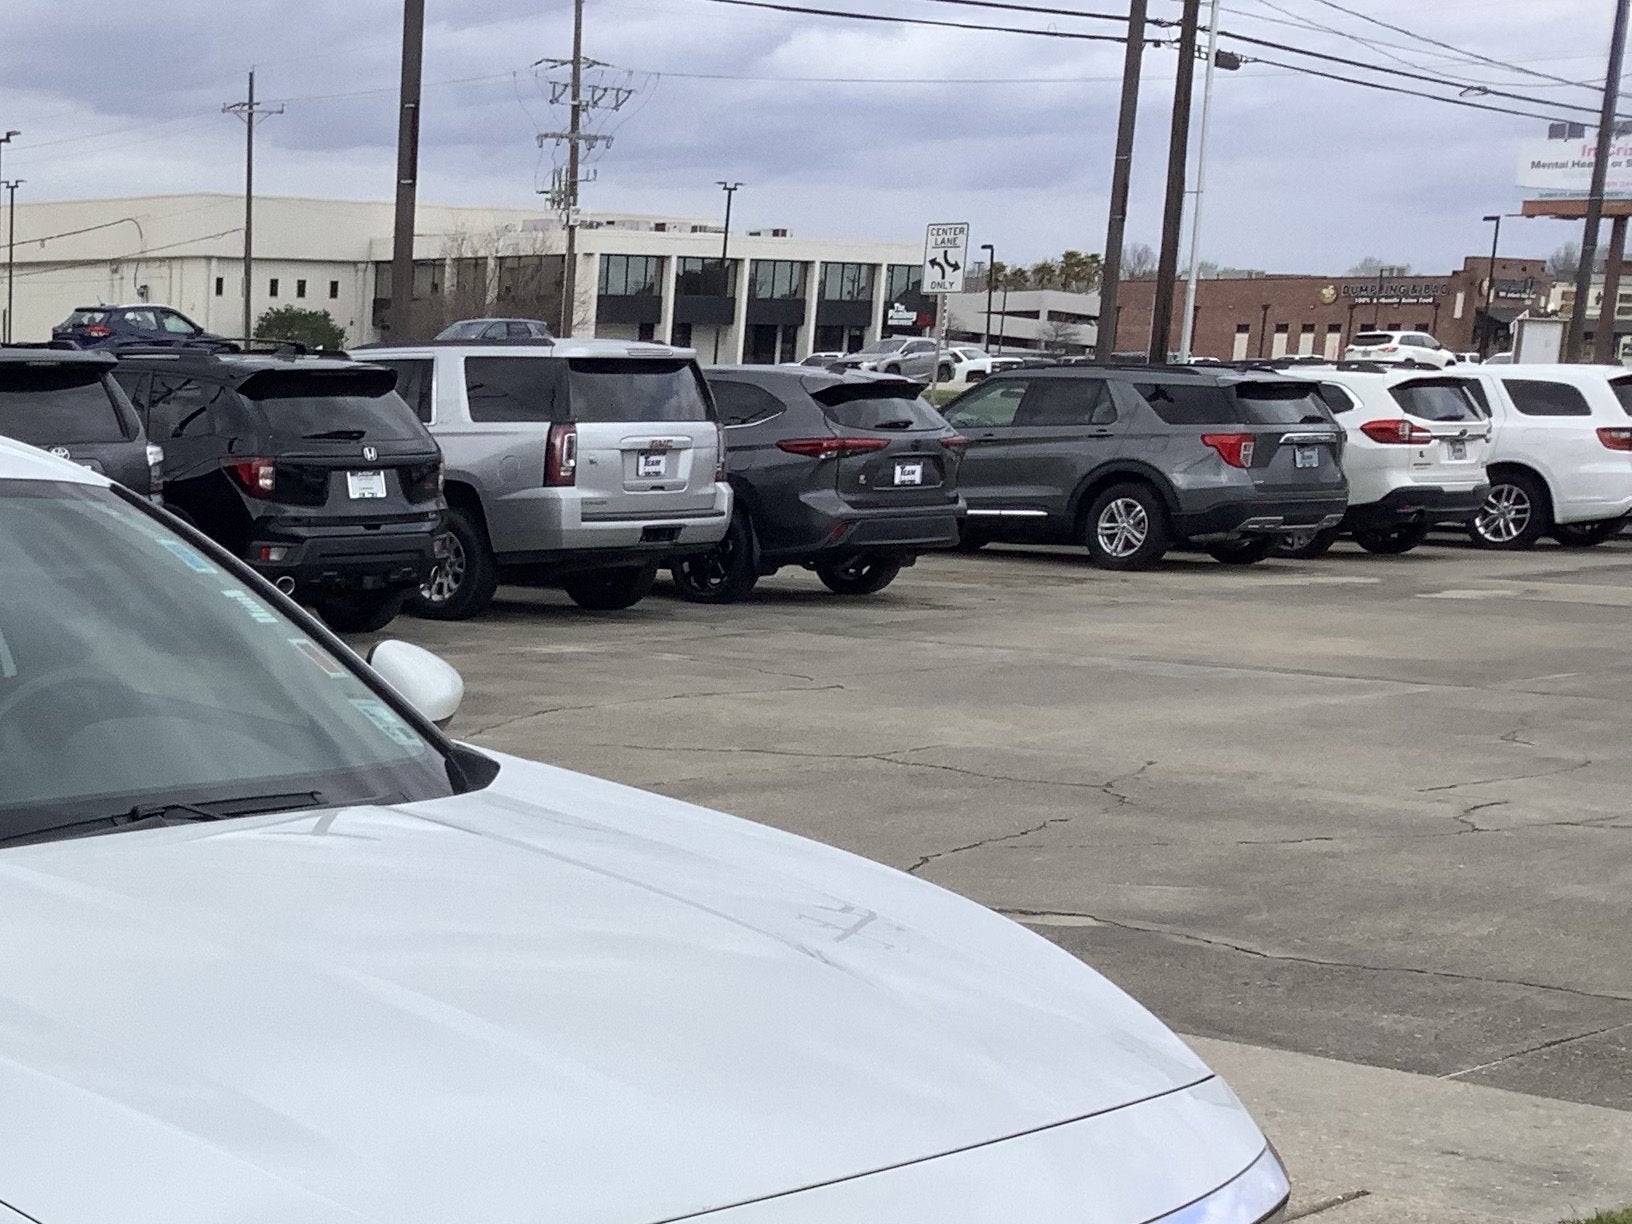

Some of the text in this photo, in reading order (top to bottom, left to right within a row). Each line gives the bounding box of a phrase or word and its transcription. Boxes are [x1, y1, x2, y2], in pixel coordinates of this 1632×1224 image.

[1530, 160, 1568, 170] Mental
[930, 227, 965, 237] CENTER
[934, 236, 959, 246] LANE
[930, 281, 955, 290] ONLY
